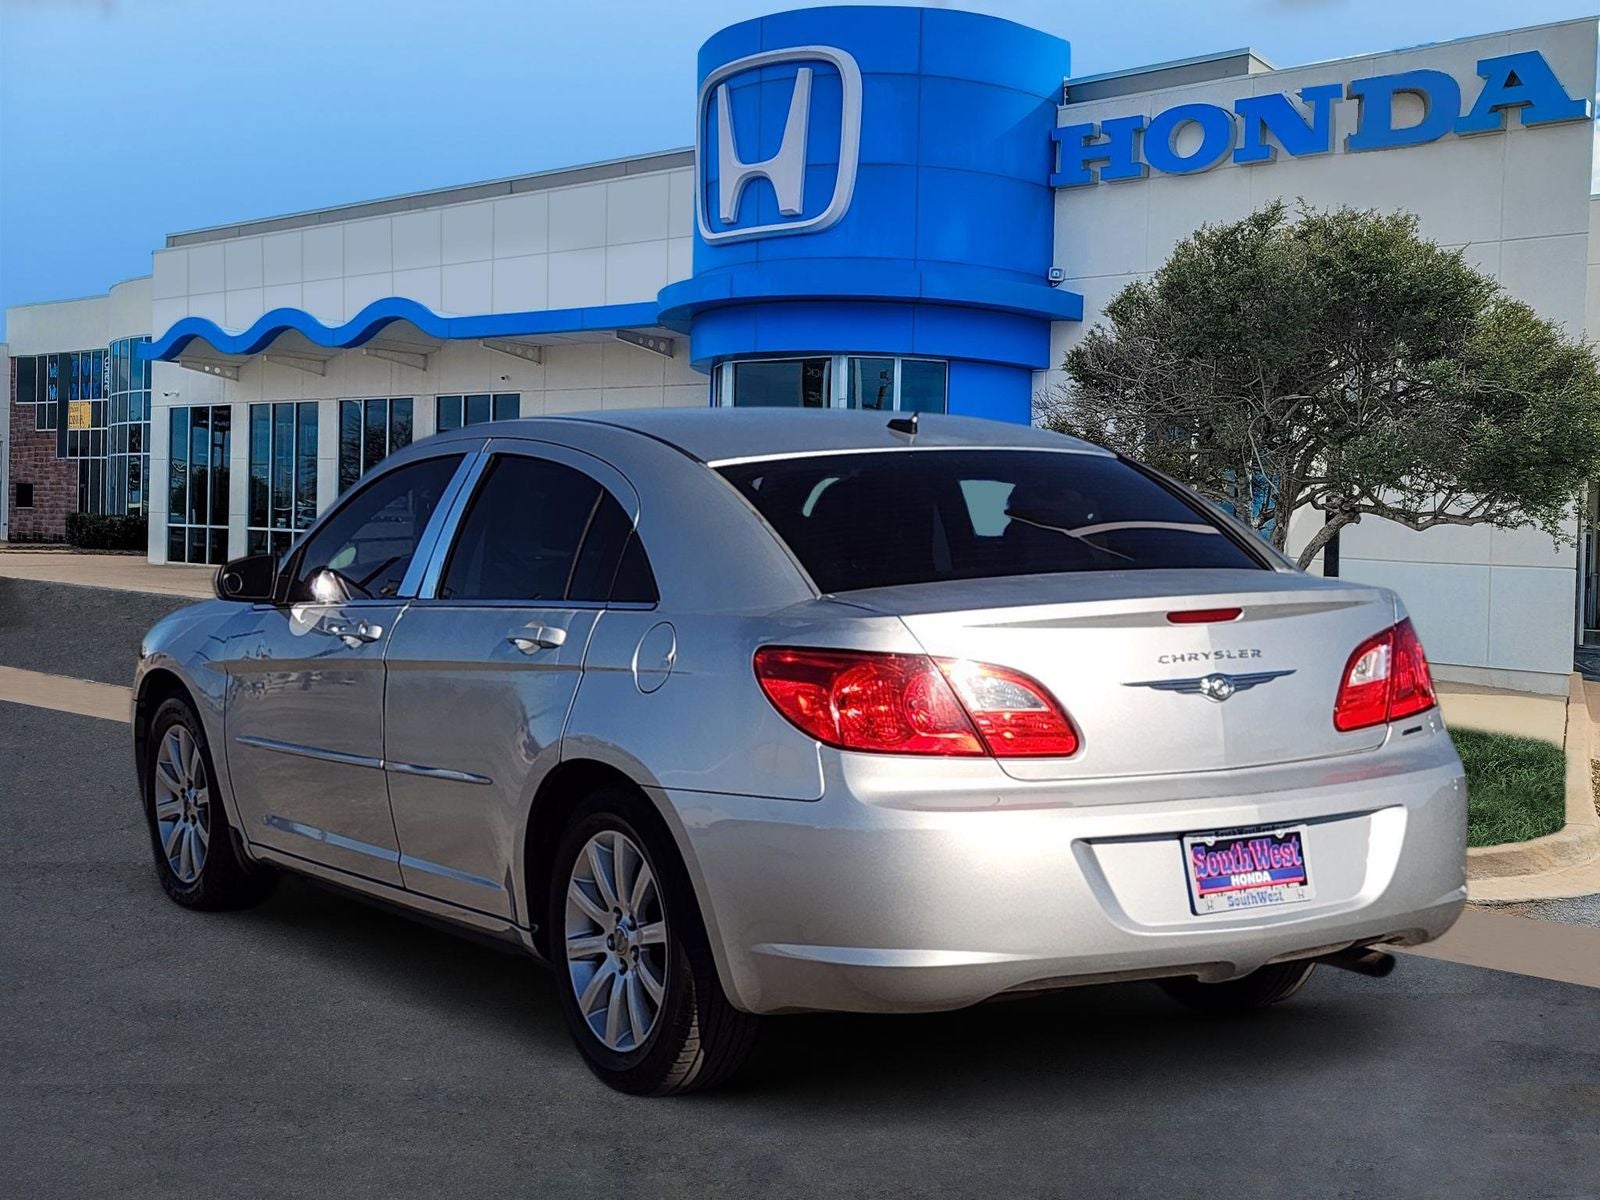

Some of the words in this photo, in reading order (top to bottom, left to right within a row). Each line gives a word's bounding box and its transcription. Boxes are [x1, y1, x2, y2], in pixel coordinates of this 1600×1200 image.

[1050, 50, 1592, 188] HONDA
[1158, 649, 1262, 664] CHRYSLER
[1191, 836, 1303, 879] SouthWest
[1230, 871, 1272, 886] HONDA
